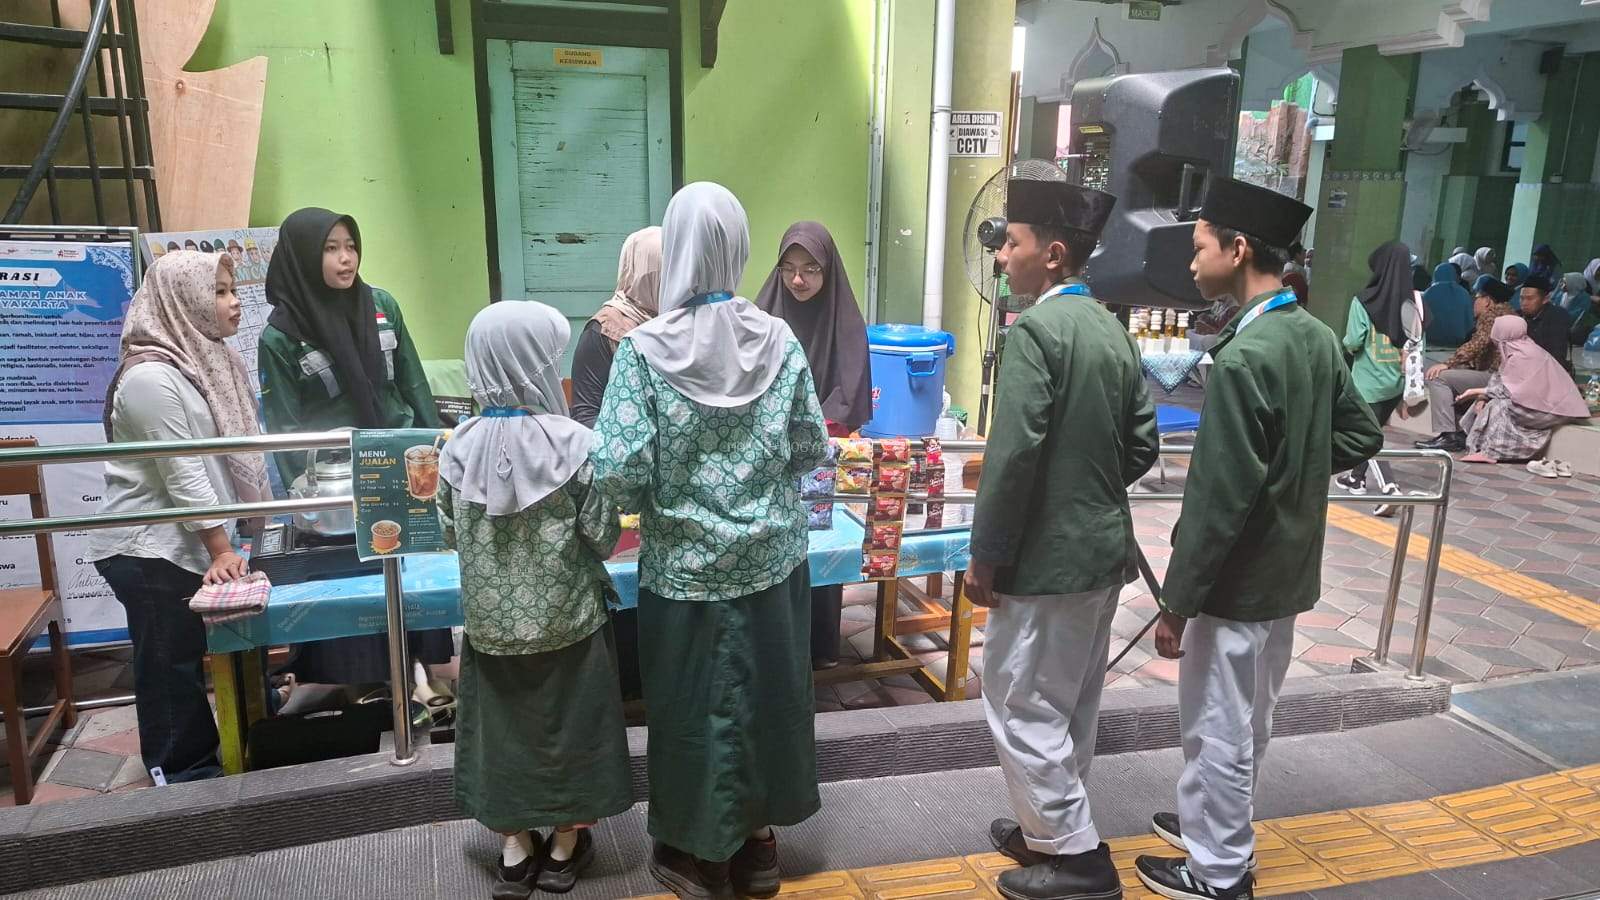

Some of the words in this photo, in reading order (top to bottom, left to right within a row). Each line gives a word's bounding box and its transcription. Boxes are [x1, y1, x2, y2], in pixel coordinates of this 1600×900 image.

[951, 114, 970, 124] AREA
[972, 114, 994, 124] DISINI
[958, 127, 987, 137] DIAWASI
[956, 138, 988, 154] CCTV
[44, 290, 88, 300] ANAK
[359, 450, 386, 458] MENU
[360, 457, 397, 466] JUALAN
